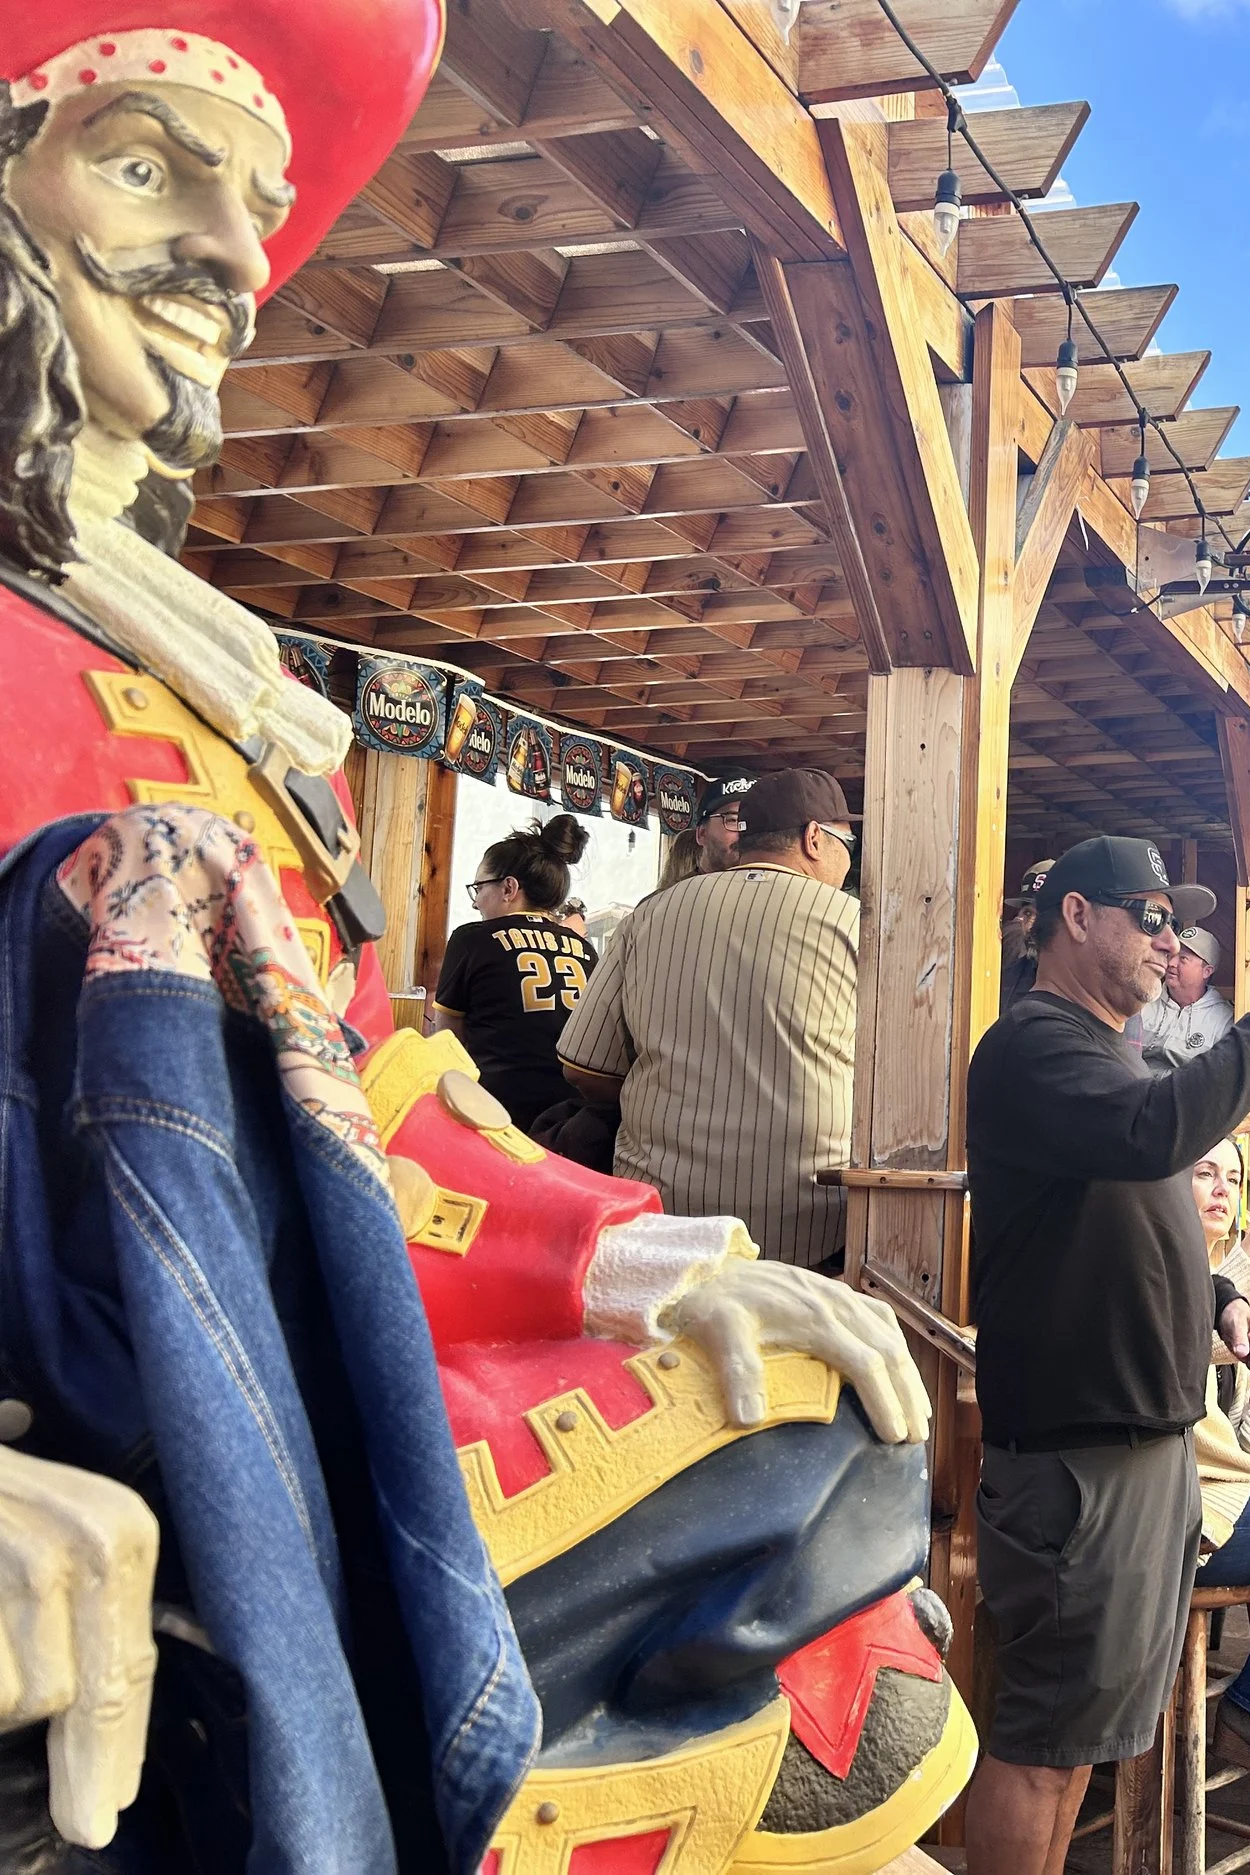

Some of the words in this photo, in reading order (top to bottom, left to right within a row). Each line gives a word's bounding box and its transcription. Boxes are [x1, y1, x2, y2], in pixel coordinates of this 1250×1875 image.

[370, 692, 431, 726] Modelo
[469, 729, 491, 754] delo
[566, 764, 595, 790] Modelo
[660, 791, 690, 816] Modelo
[492, 928, 559, 952] TATIS
[561, 935, 592, 962] JR.
[516, 951, 588, 1013] 23
